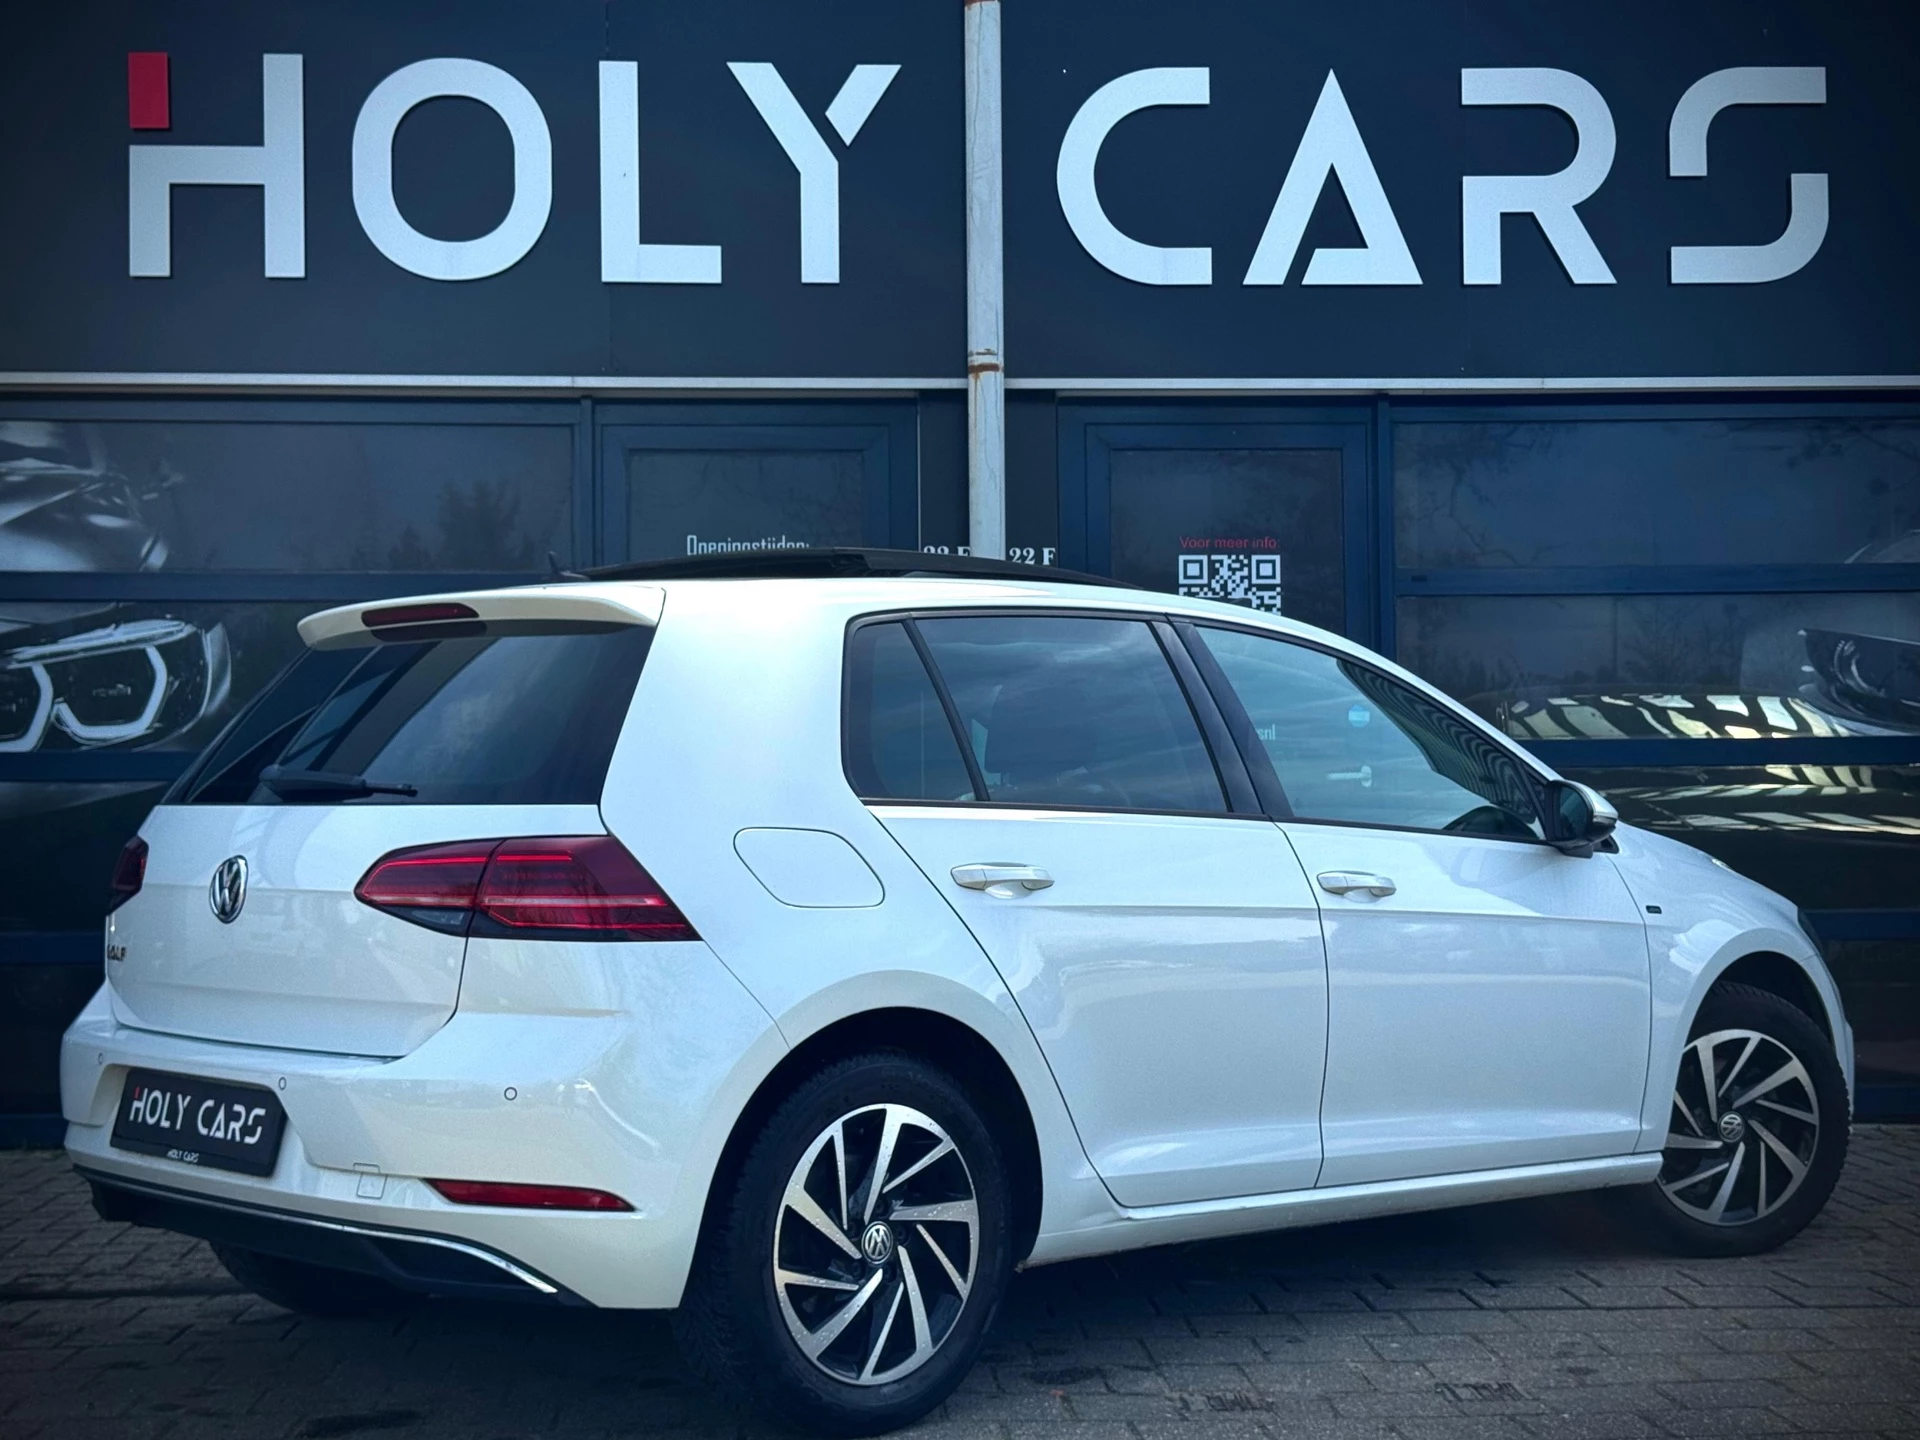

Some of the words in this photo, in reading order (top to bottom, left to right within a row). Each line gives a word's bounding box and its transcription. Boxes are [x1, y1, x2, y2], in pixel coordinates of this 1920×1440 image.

[129, 53, 901, 283] HOLY
[1056, 66, 1828, 285] CARS
[1179, 536, 1211, 548] Voor
[1214, 538, 1249, 548] meer
[1009, 547, 1035, 565] 22
[1042, 547, 1056, 565] F
[129, 1087, 192, 1131] HOLY
[197, 1099, 266, 1145] CARS
[167, 1149, 183, 1159] HOLY
[183, 1151, 200, 1163] CARS
